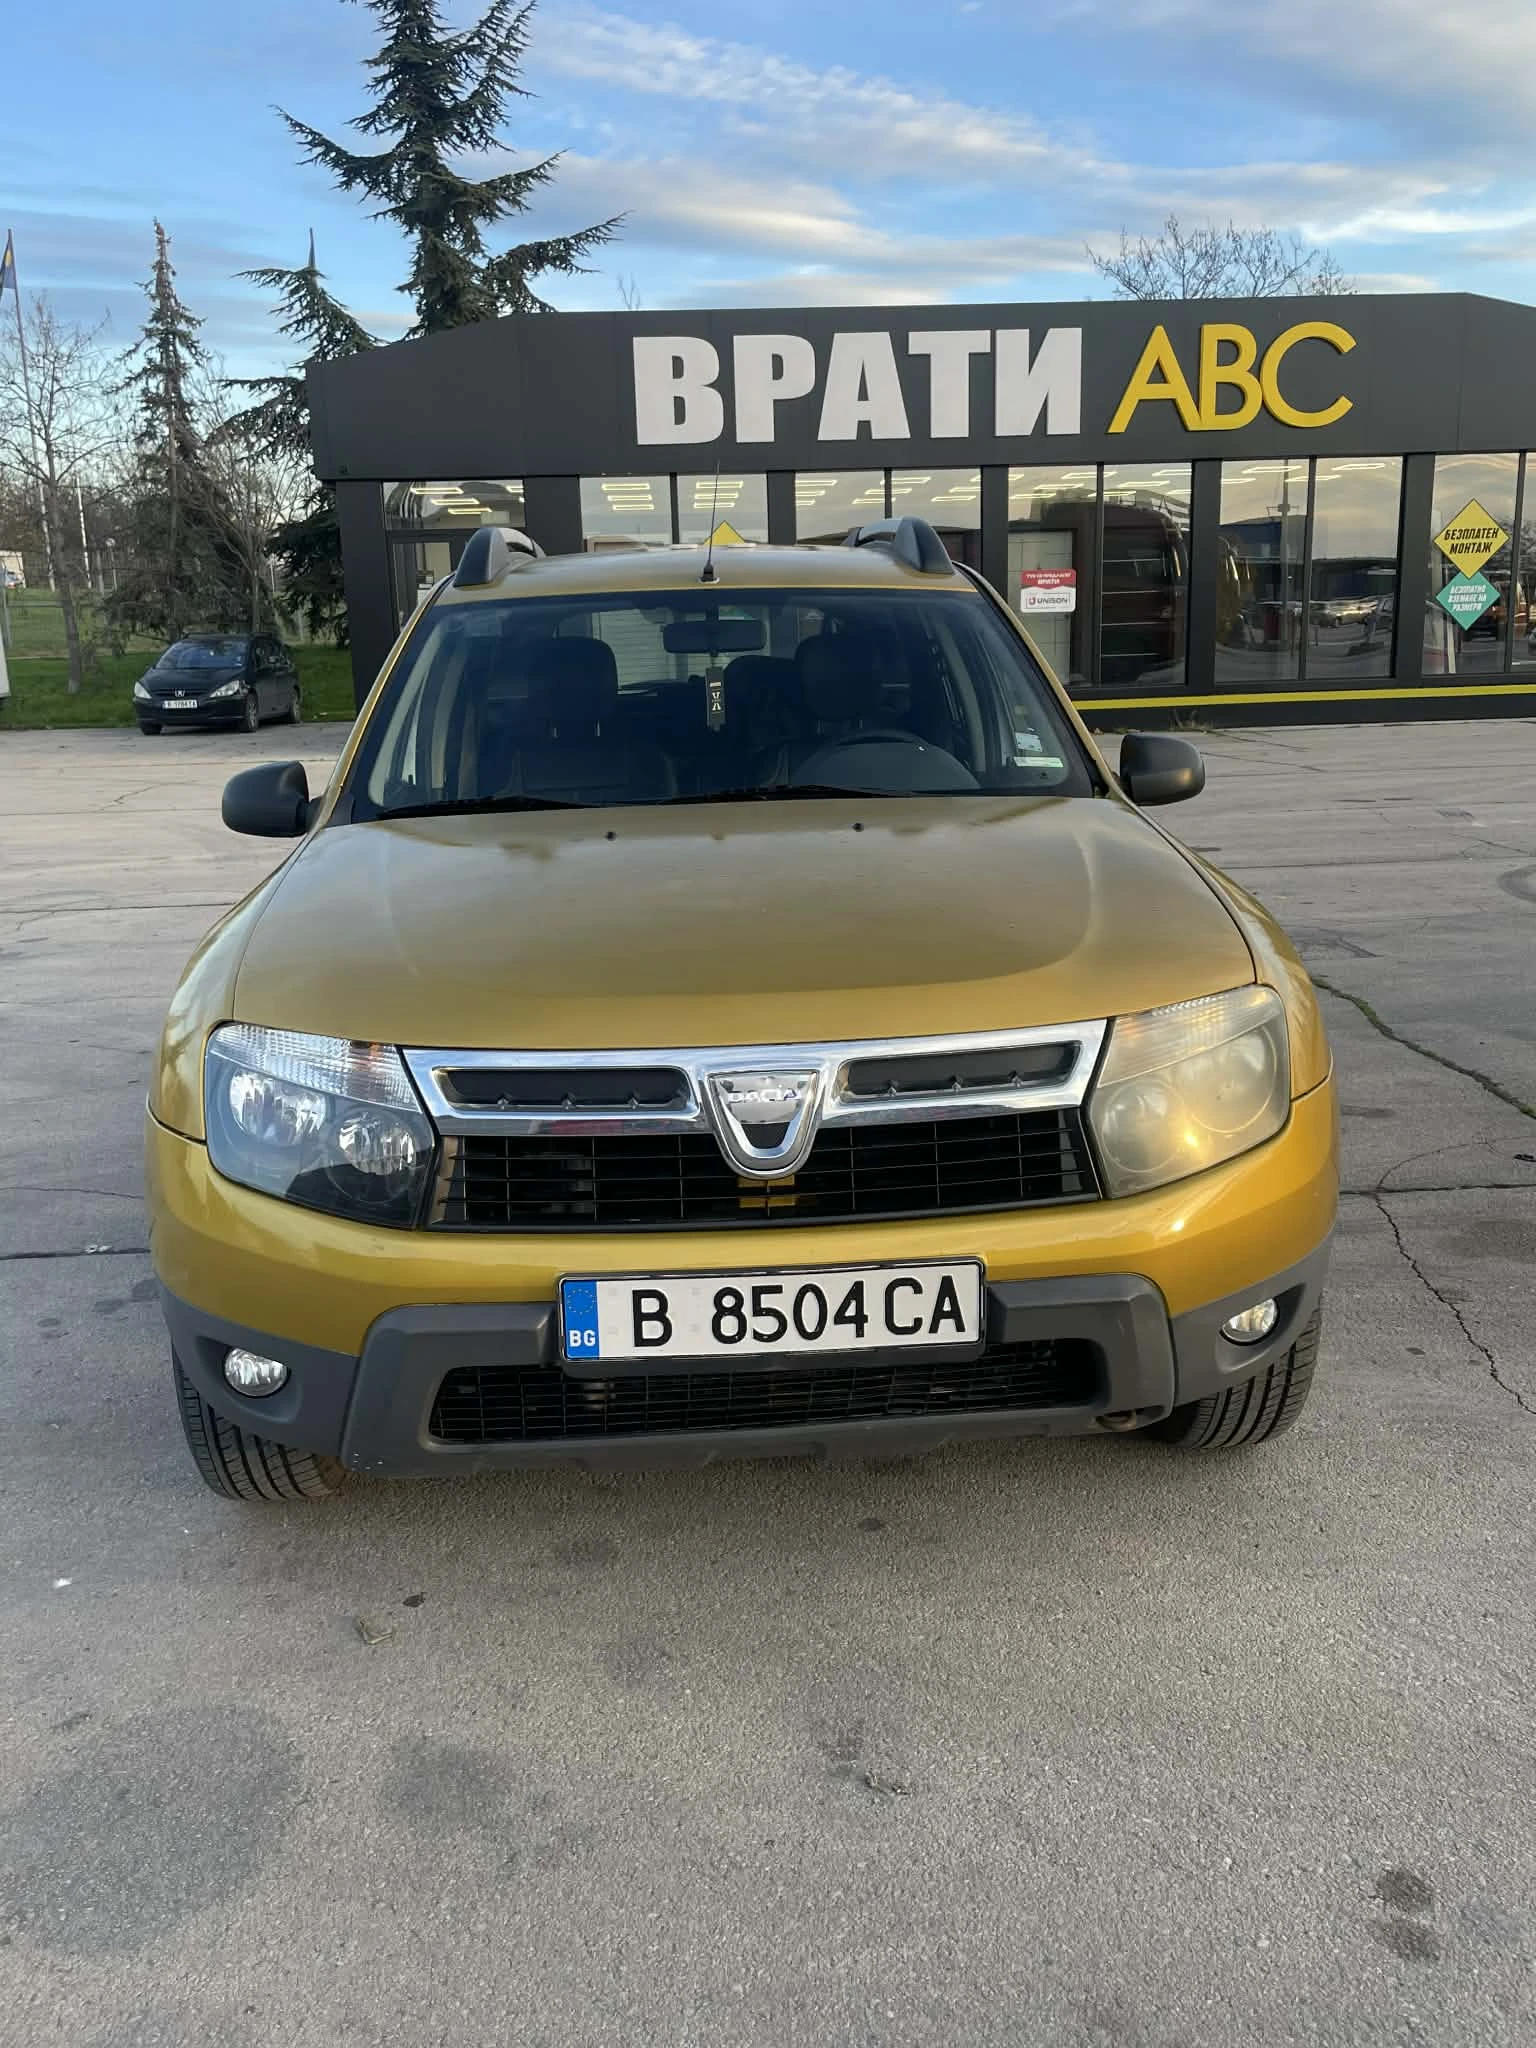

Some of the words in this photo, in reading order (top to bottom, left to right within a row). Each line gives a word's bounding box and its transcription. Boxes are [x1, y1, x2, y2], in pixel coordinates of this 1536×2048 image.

[632, 327, 1082, 446] ВРАТИ
[1106, 322, 1357, 434] ABC
[1444, 527, 1499, 541] БЕЗПЛАТЕН
[1449, 542, 1493, 555] МОНТАЖ
[631, 1288, 674, 1348] B
[711, 1280, 869, 1345] 8504
[883, 1275, 967, 1336] CA
[569, 1329, 597, 1348] BG
